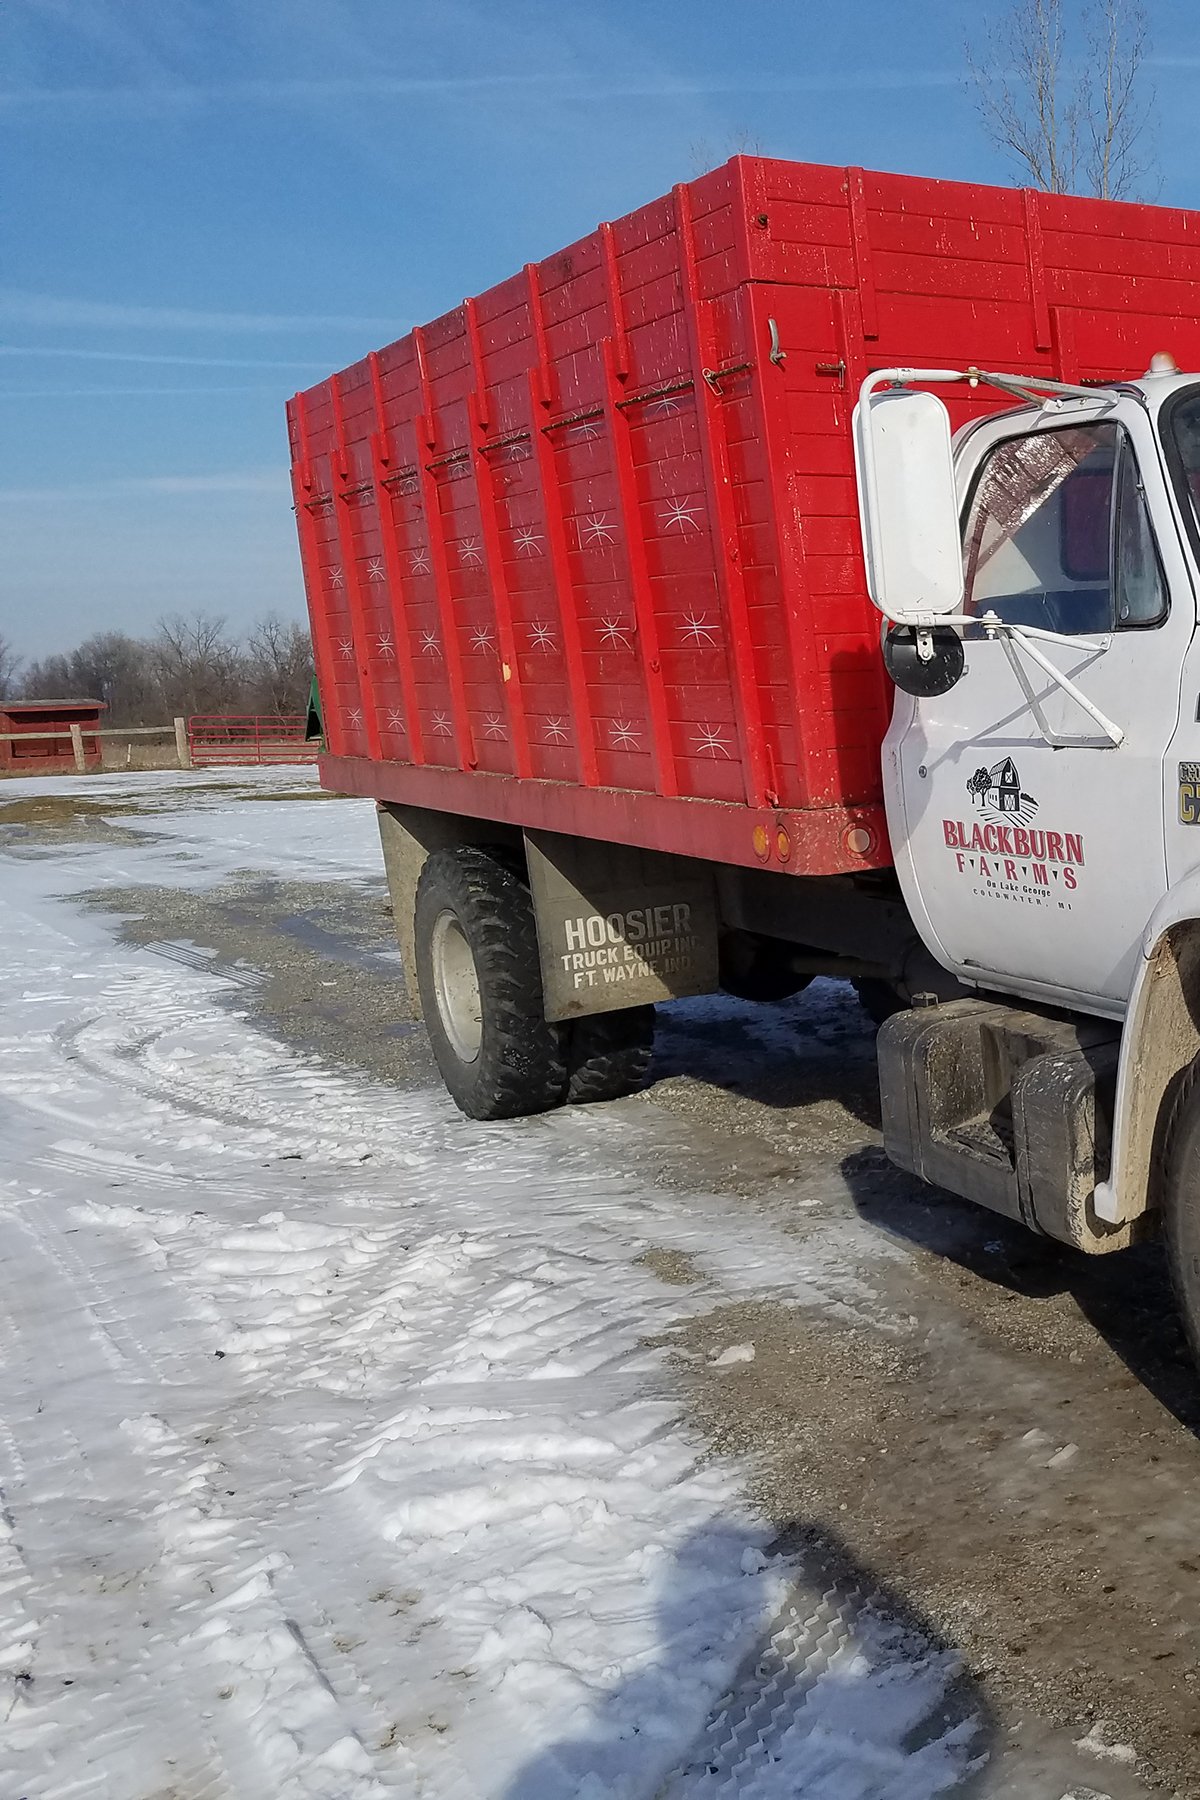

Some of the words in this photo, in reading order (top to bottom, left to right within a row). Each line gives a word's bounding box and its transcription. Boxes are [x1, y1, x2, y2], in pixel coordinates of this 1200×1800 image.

[942, 819, 1086, 866] BLACKBURN
[986, 880, 997, 888] On
[1000, 881, 1019, 892] Lake
[1023, 885, 1052, 897] George
[564, 903, 692, 951] HOOSIER
[561, 946, 619, 971] TRUCK
[573, 970, 598, 989] FT.
